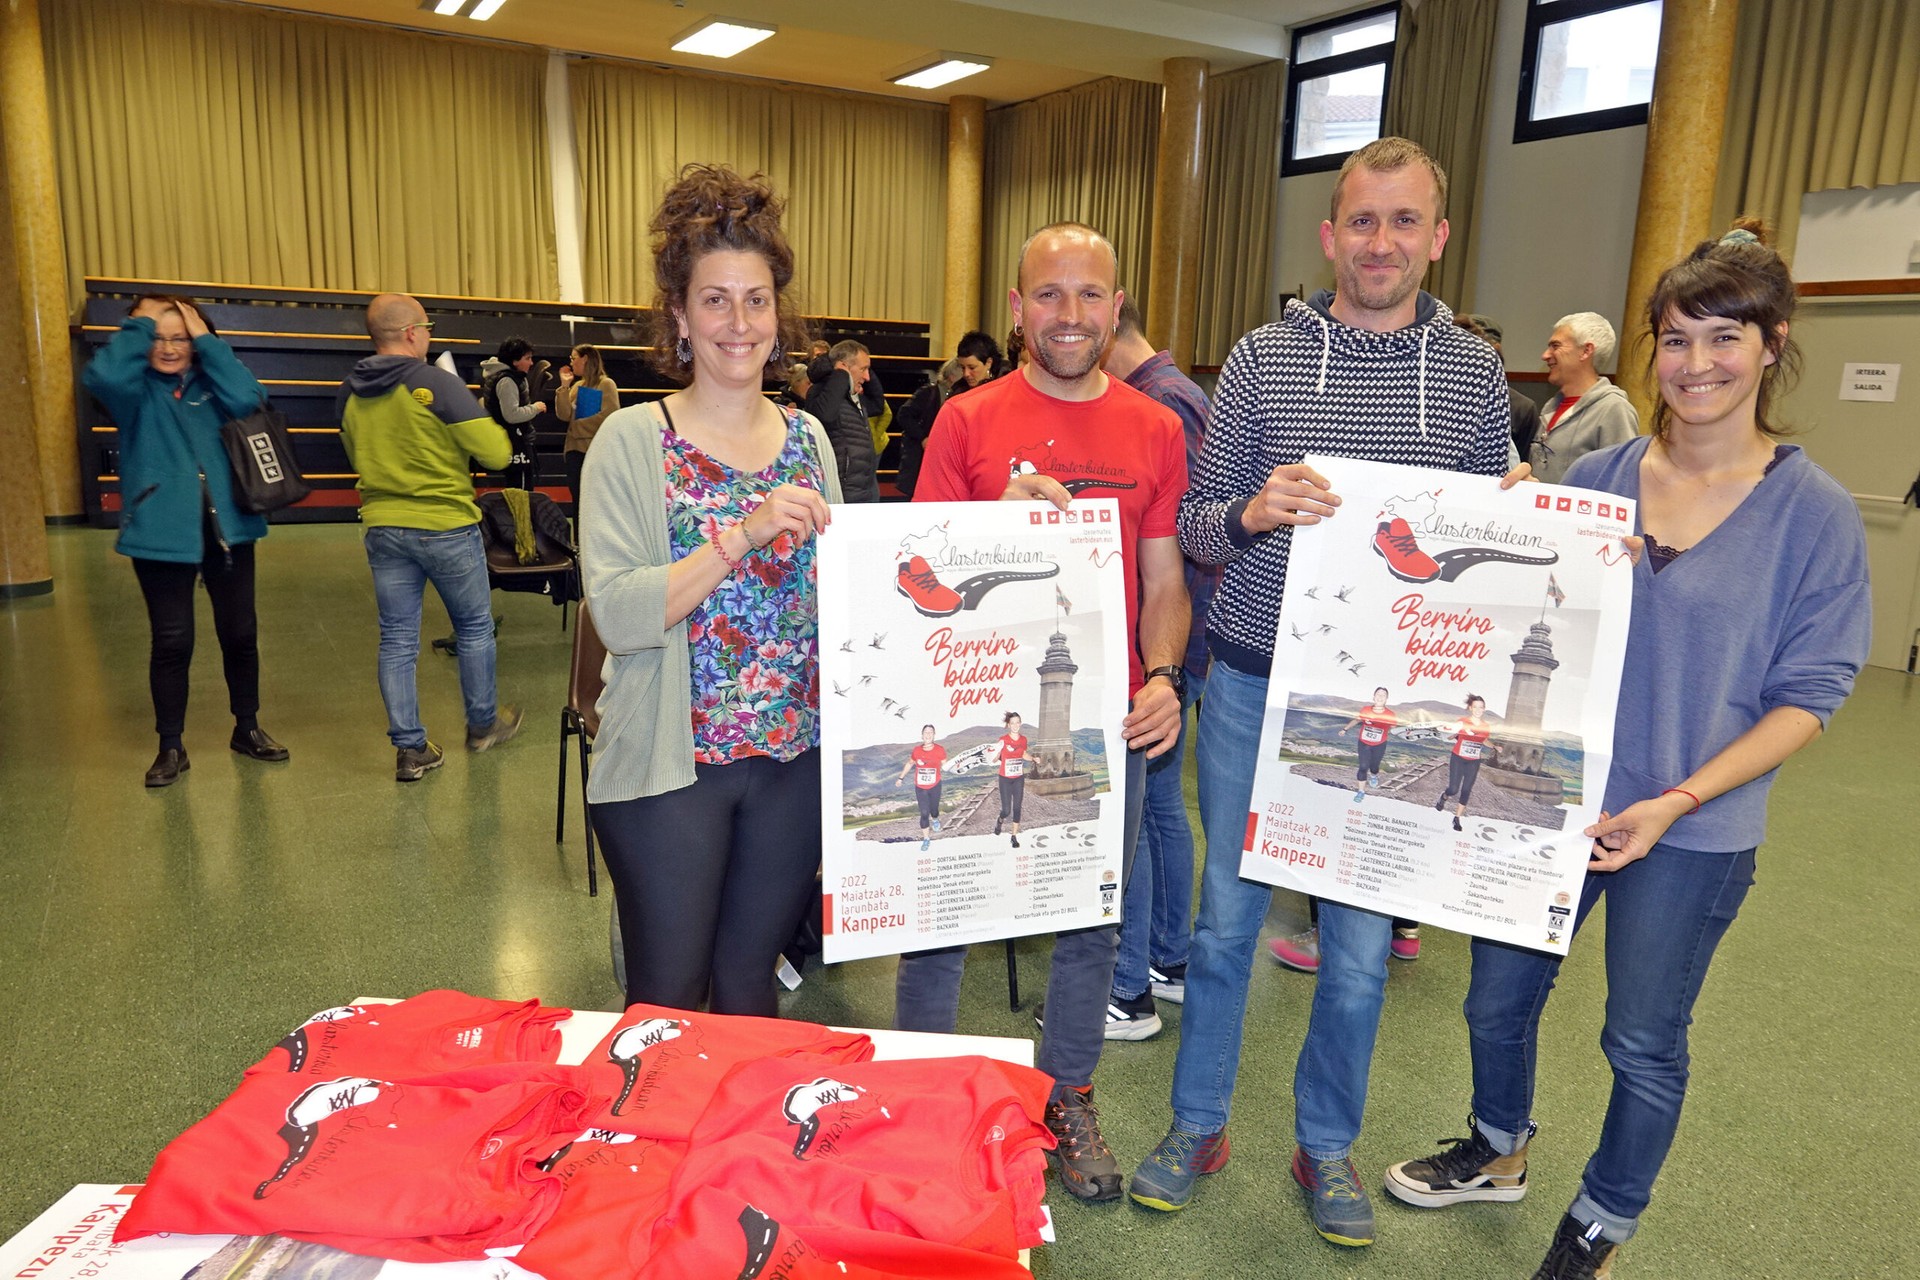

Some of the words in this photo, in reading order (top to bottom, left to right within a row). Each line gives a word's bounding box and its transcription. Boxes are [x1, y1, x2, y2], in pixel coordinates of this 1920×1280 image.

[1391, 593, 1496, 635] Berriro
[925, 626, 1019, 667] Berriro
[1405, 627, 1490, 659] bidean
[943, 660, 1019, 688] bidean
[1406, 658, 1469, 686] gara
[949, 688, 1004, 718] gara
[1268, 802, 1295, 817] 2022
[1347, 809, 1362, 818] 09:00
[1368, 813, 1390, 823] DORTSAL
[1392, 818, 1418, 828] BANAKETA
[1265, 815, 1310, 834] Maiatzak
[1313, 824, 1330, 840] 28.
[1367, 821, 1384, 831] ZUNBA
[1385, 825, 1410, 836] BEROKETA
[1263, 827, 1312, 847] larunbata
[1368, 830, 1382, 839] zehar
[1383, 833, 1397, 842] mural
[1398, 837, 1426, 849] margoketa
[958, 853, 982, 861] BANAKETA
[1261, 839, 1327, 869] Kanpezu
[1362, 847, 1392, 860] LASTERKETA
[1393, 853, 1410, 863] LUZEA
[1340, 851, 1355, 859] 12:30
[1360, 856, 1391, 868] LASTERKETA
[1392, 862, 1415, 874] LABURRA
[1528, 865, 1538, 874] eta
[967, 869, 992, 878] margoketa
[1357, 872, 1382, 884] EKITALDIA
[1359, 864, 1371, 873] SARI
[1371, 867, 1397, 879] BANAKETA
[1471, 873, 1508, 886] KONTZERTUAK
[1488, 866, 1505, 876] PILOTA
[1506, 870, 1532, 881] PARTIDUA
[841, 875, 867, 888] 2022
[1355, 881, 1380, 892] BAZKARIA
[841, 888, 885, 902] Maiatzak
[889, 885, 904, 897] 28.
[936, 889, 965, 897] LASTERKETA
[841, 903, 889, 915] larunbata
[936, 898, 964, 906] LASTERKETA
[1474, 910, 1483, 918] eta
[842, 914, 905, 934] Kanpezu
[15, 1204, 127, 1278] Kanpezu
